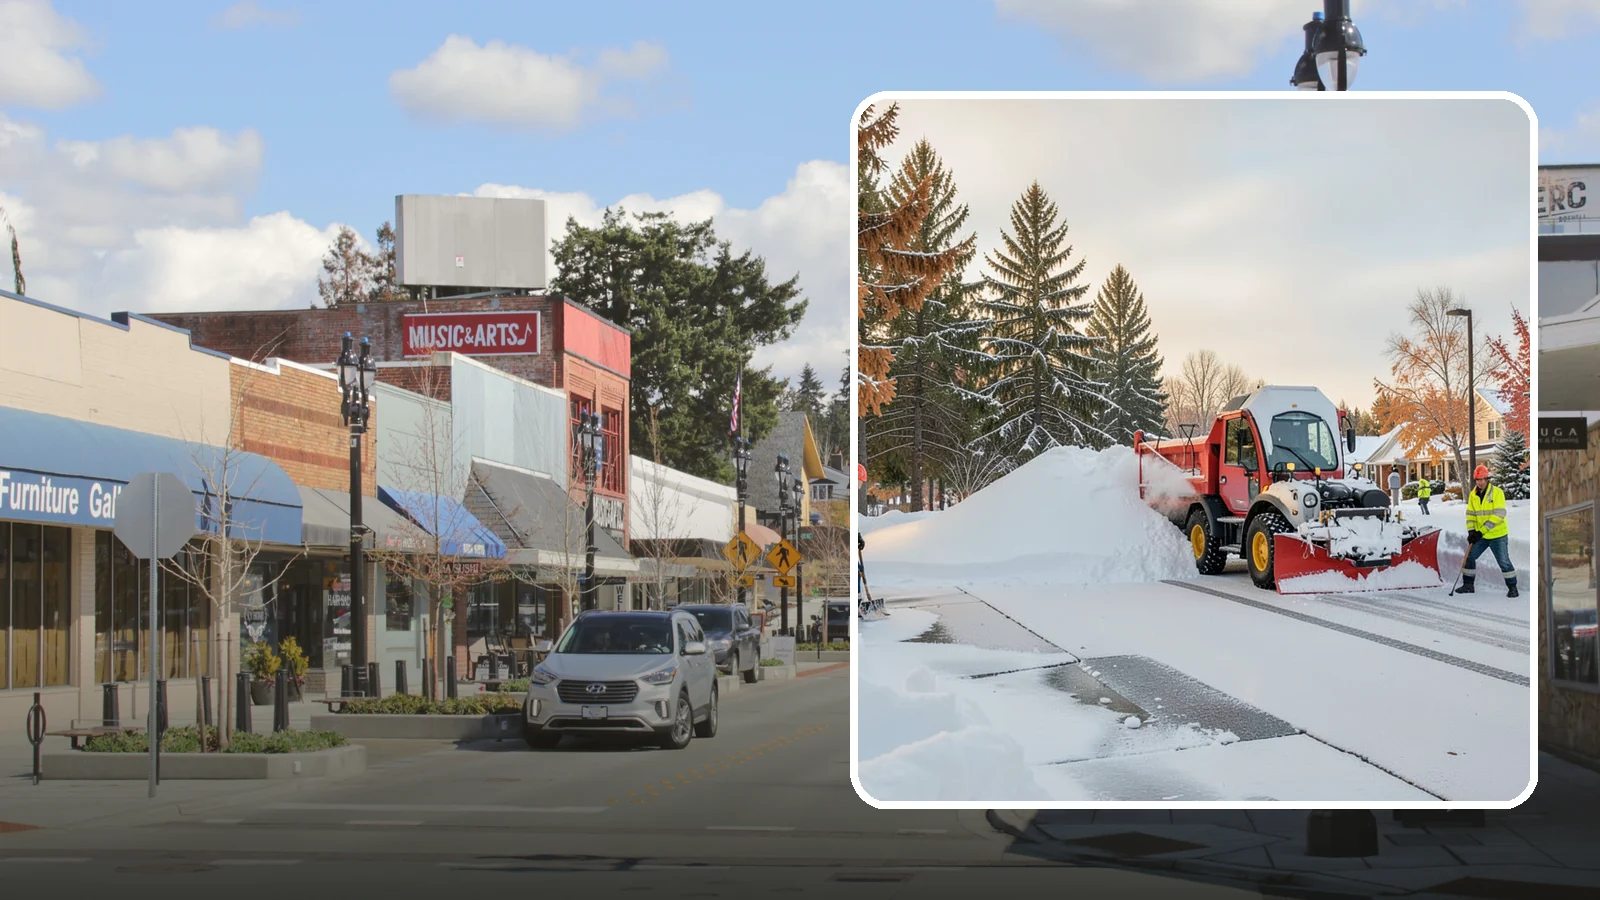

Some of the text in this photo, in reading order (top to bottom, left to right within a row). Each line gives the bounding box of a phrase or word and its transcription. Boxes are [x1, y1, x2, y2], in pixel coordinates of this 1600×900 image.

[0, 471, 122, 519] Furniture Gal
[453, 563, 479, 574] SUSHI
